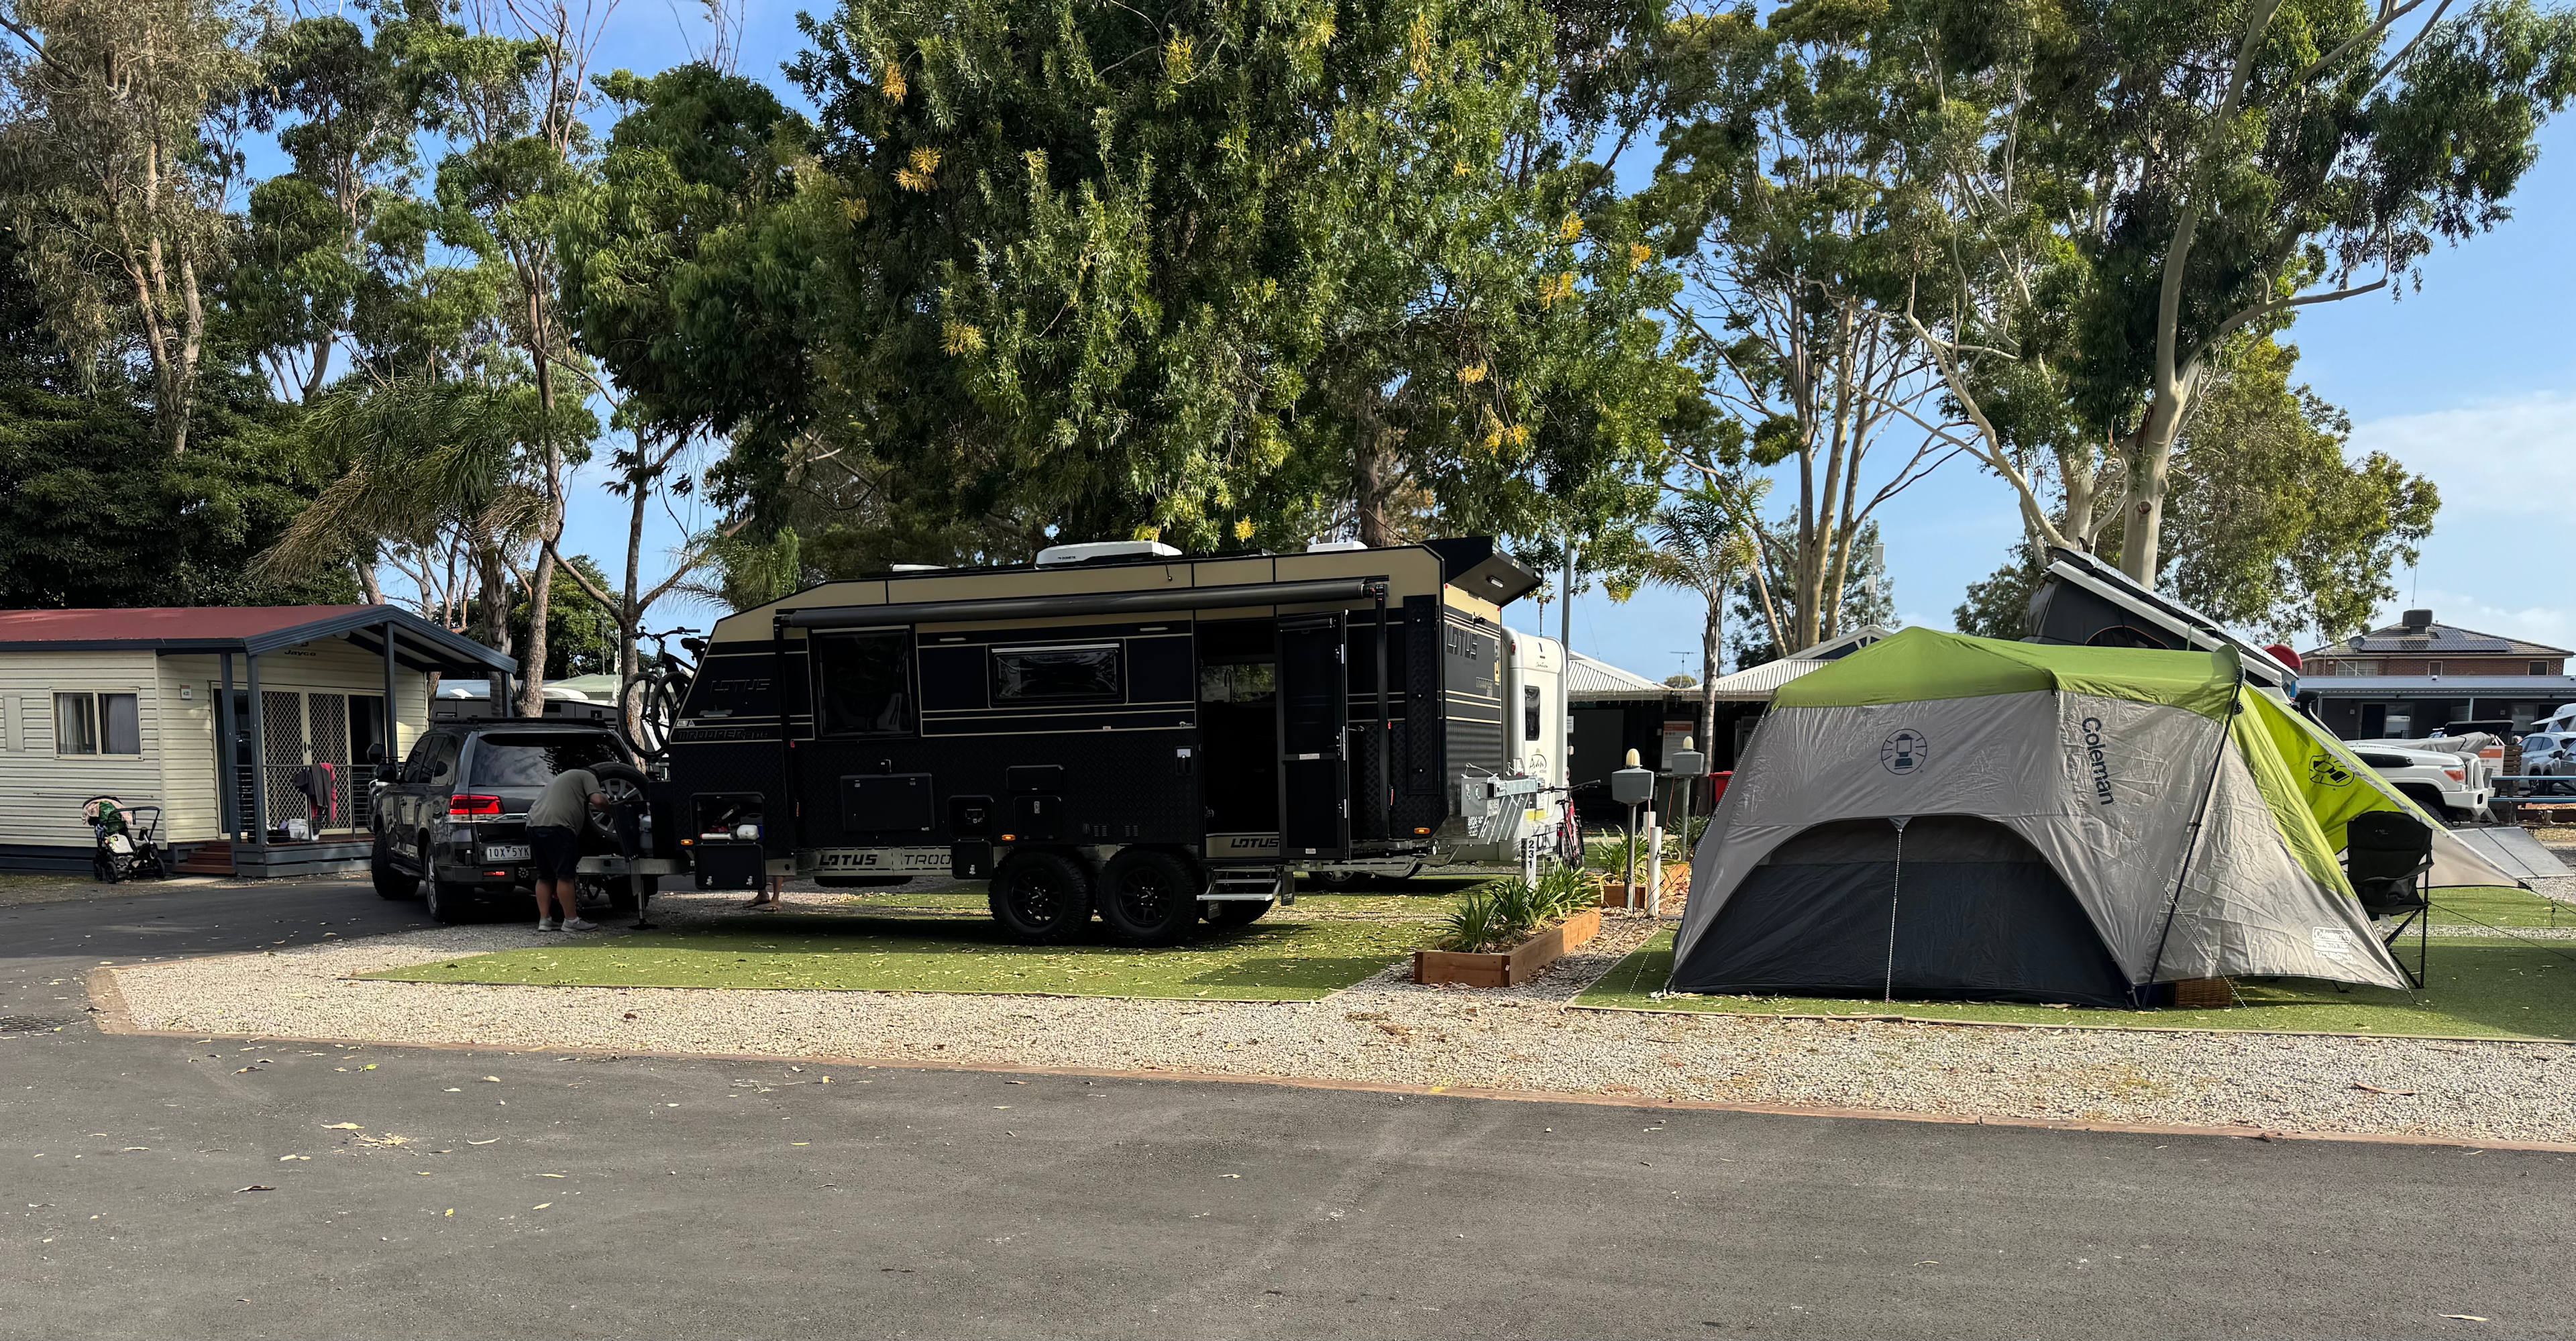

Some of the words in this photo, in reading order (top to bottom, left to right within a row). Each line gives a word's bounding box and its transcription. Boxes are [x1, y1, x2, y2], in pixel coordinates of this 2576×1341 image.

[1445, 623, 1478, 661] LOTUS
[709, 678, 771, 694] LOTUS
[2082, 717, 2114, 805] Coleman
[1230, 838, 1280, 848] LOTUS
[819, 854, 878, 866] LOTUS
[2314, 929, 2343, 941] Coleman
